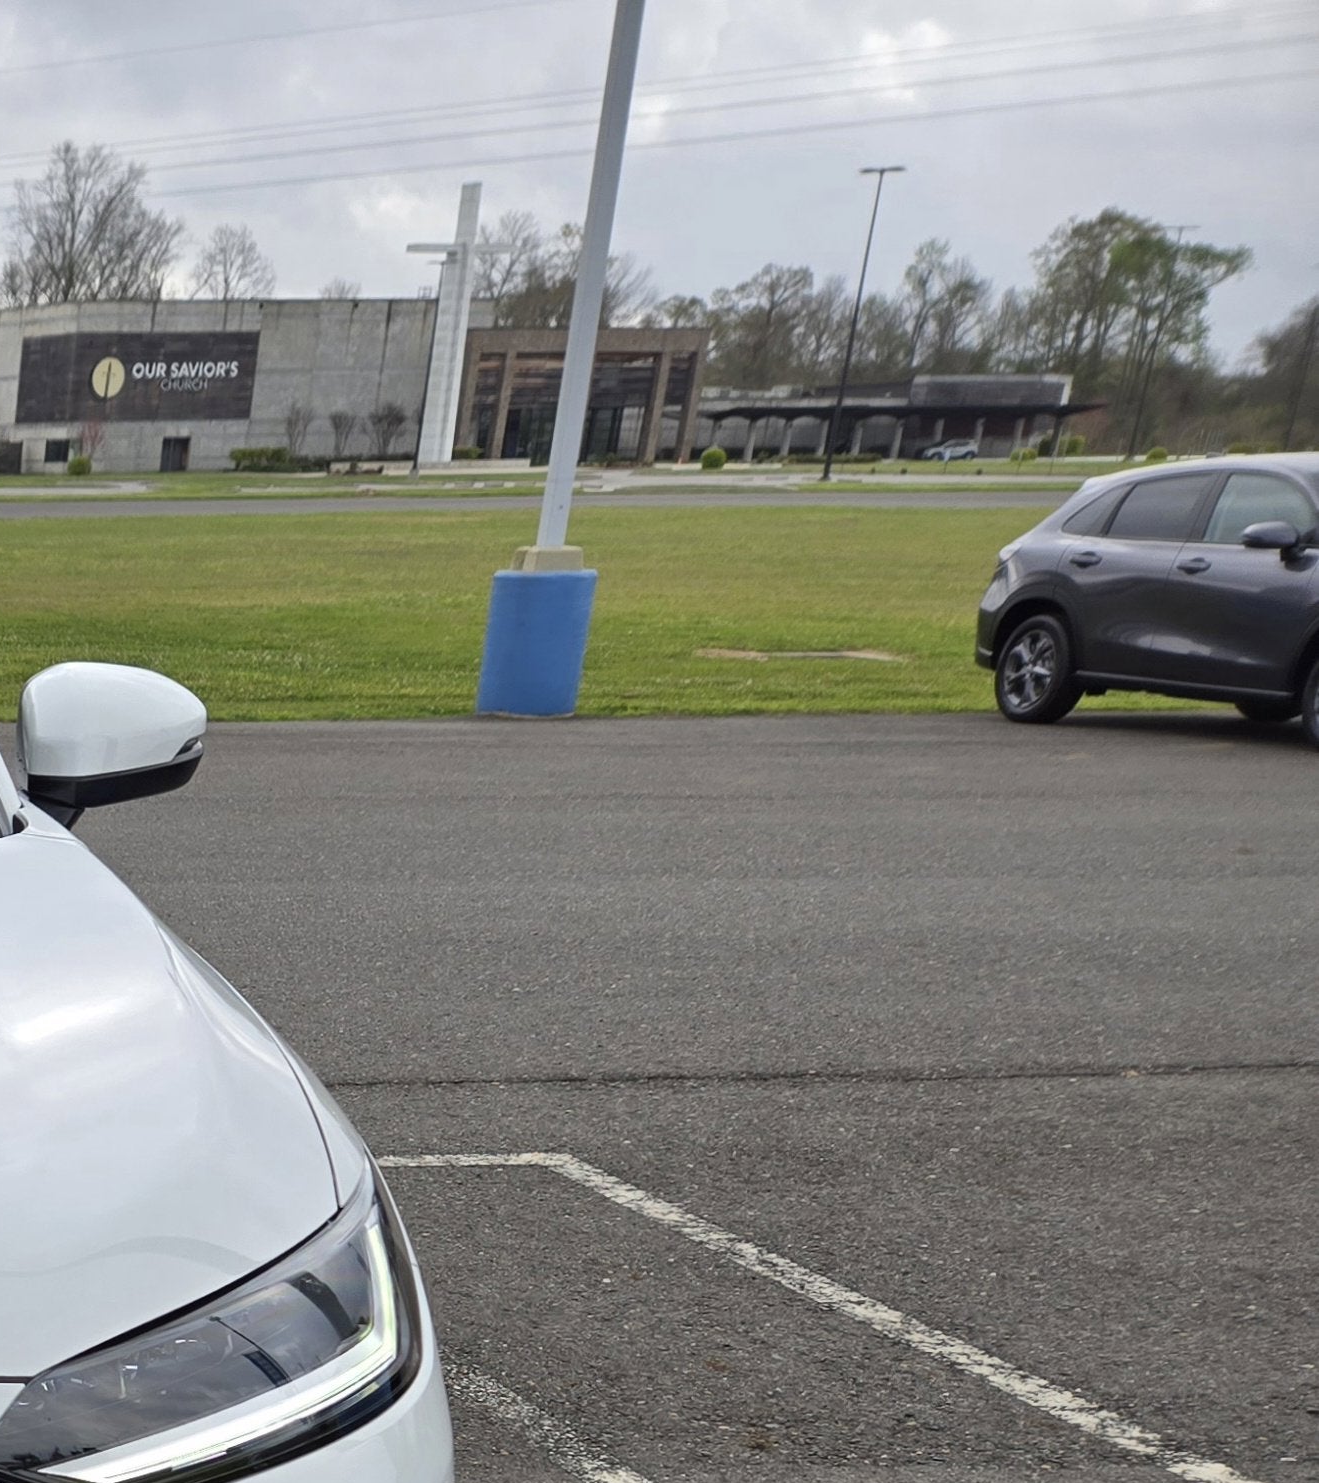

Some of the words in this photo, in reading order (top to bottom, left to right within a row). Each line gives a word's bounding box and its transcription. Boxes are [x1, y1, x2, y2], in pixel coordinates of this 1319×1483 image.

[132, 362, 166, 379] OUR
[170, 361, 240, 378] SAVIOR'S
[159, 378, 209, 391] CHURCH
